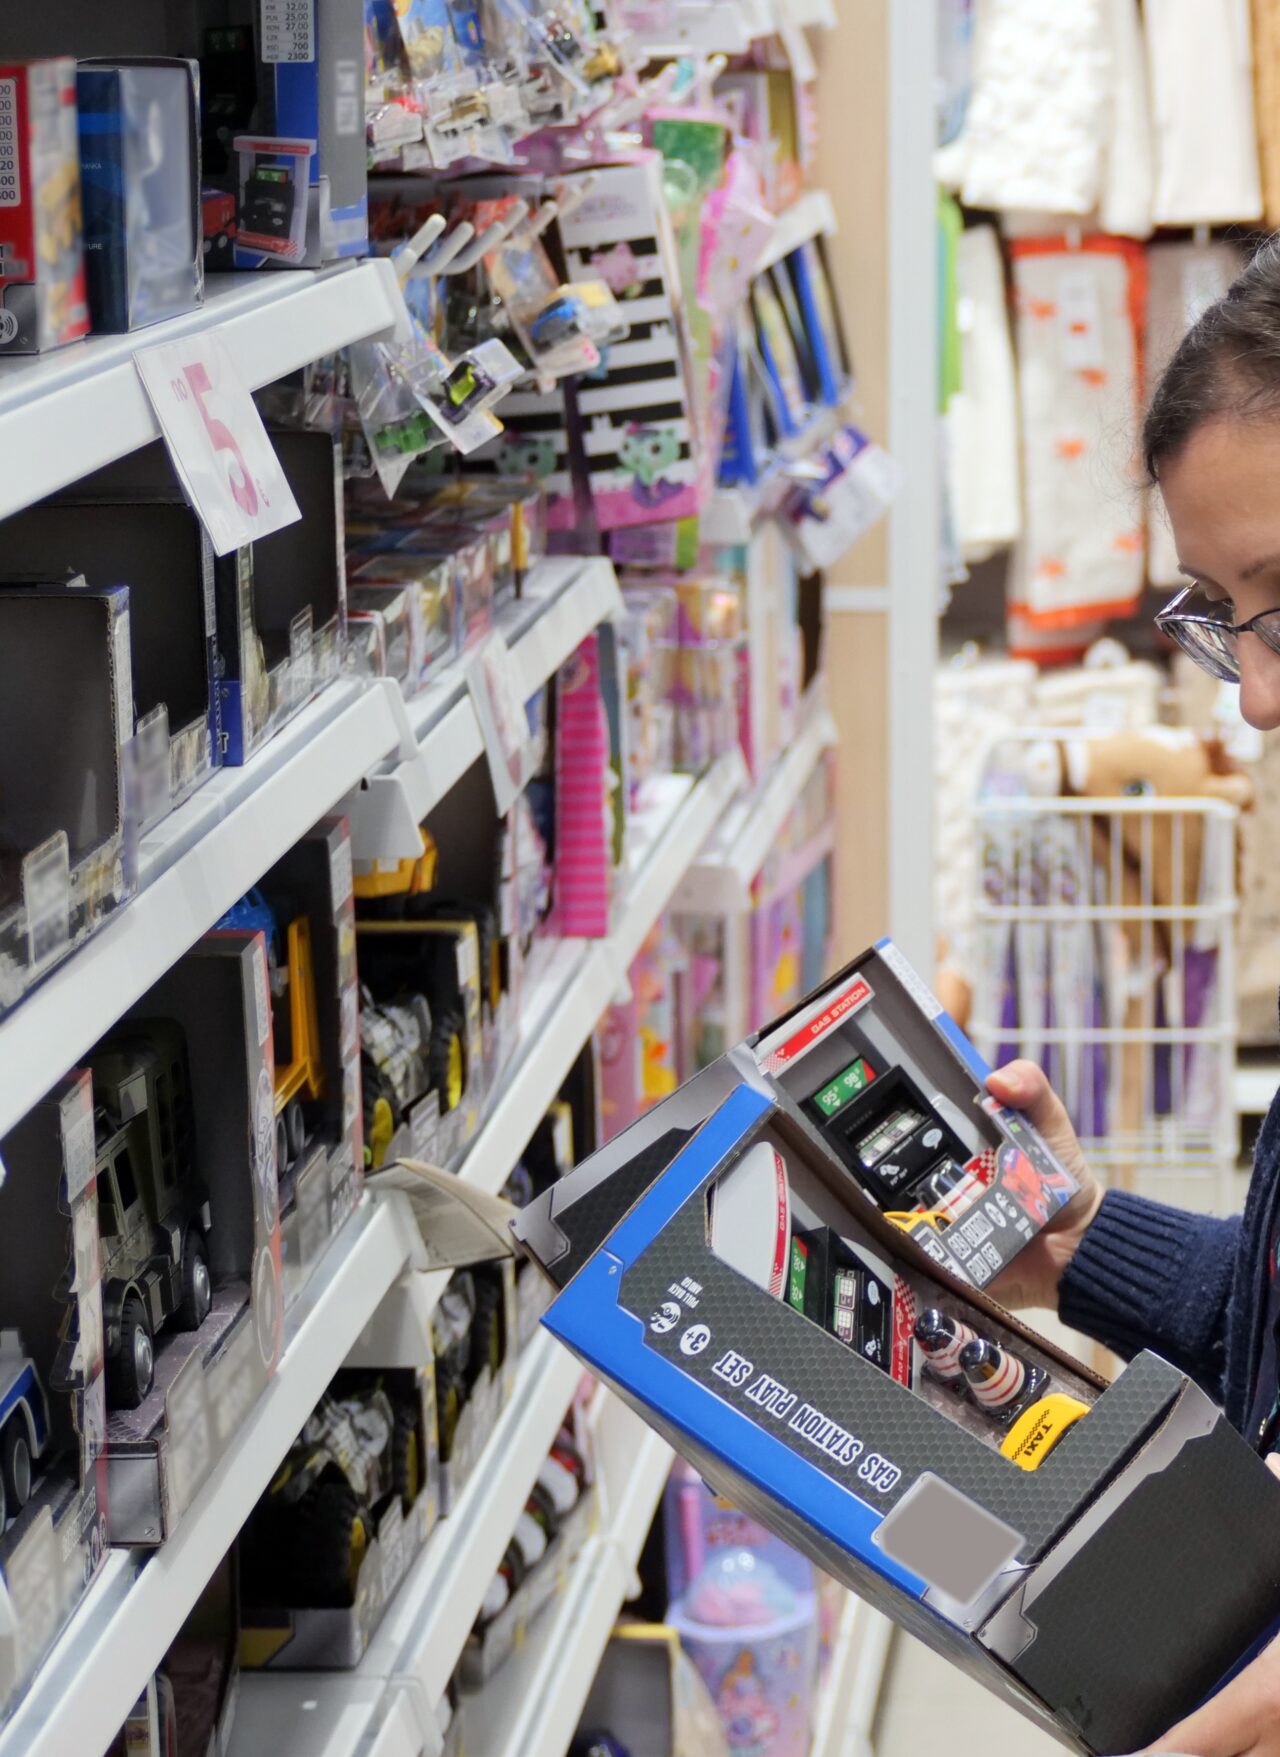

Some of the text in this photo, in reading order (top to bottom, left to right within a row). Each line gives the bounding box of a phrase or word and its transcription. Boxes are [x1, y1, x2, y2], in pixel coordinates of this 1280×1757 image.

[292, 32, 309, 41] 150
[292, 42, 309, 50] 700
[287, 52, 309, 60] 2300
[183, 362, 258, 517] 5
[810, 985, 867, 1035] GAS STATION
[960, 1210, 995, 1249] STATION
[682, 1291, 701, 1309] PULL
[711, 1350, 902, 1493] GAS STATION PLAY SET
[1023, 1423, 1053, 1457] TAXI
